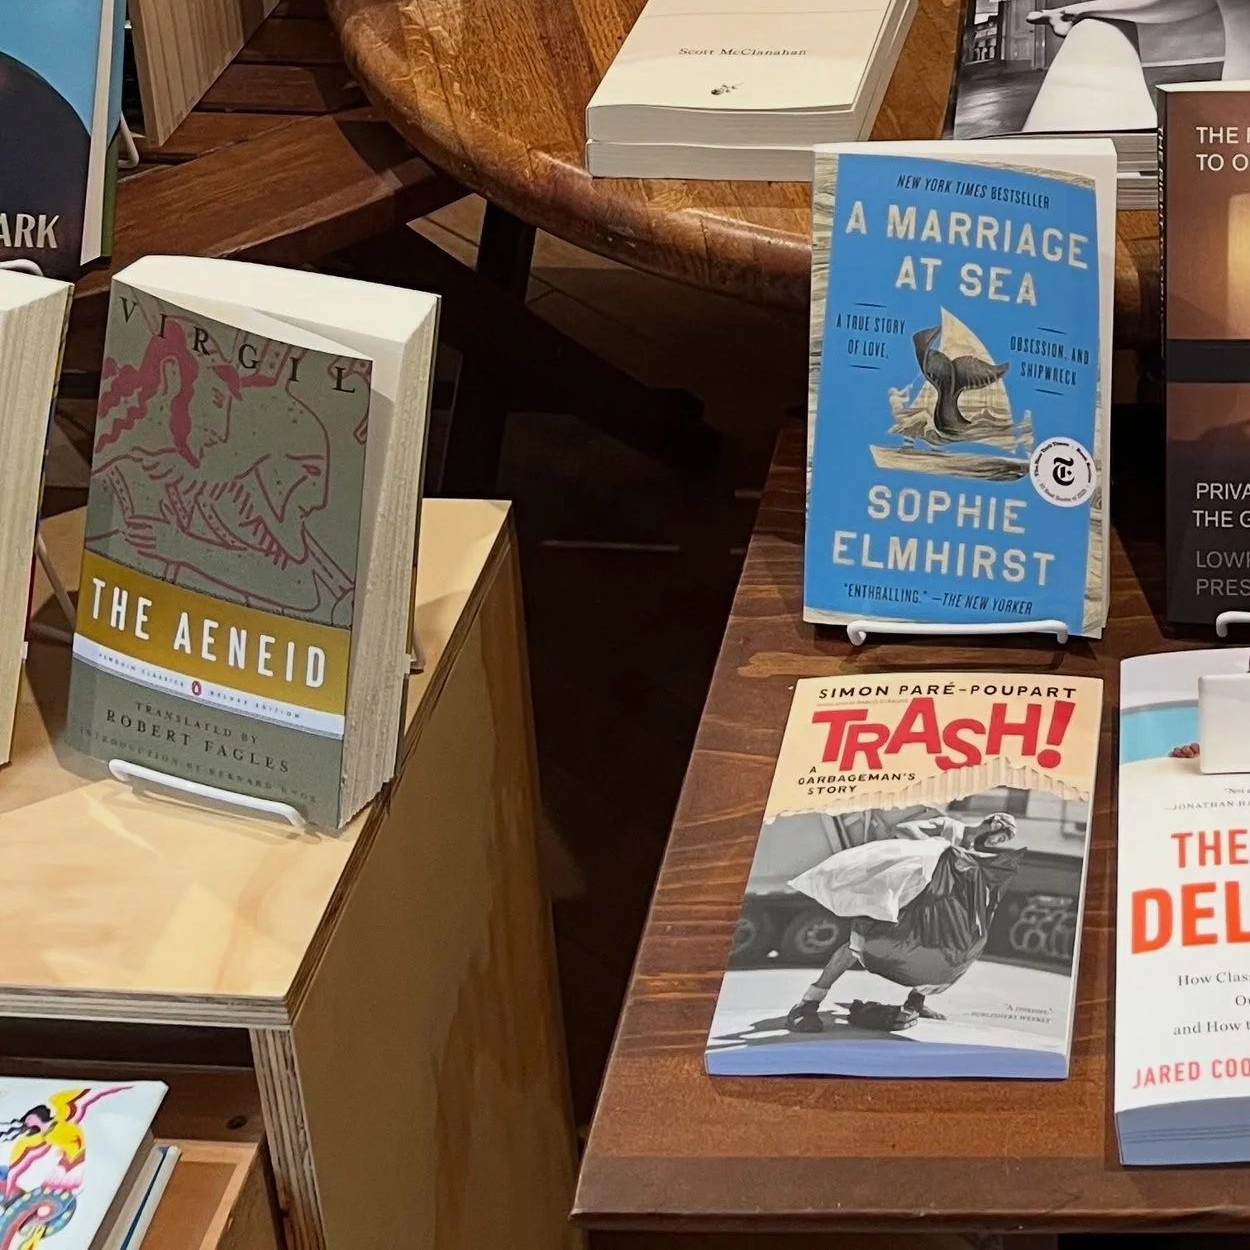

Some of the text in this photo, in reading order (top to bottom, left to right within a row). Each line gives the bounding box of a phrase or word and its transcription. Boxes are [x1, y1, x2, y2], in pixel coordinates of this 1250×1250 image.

[679, 47, 808, 56] Scott McClanahan
[1196, 126, 1238, 144] THE
[1196, 153, 1224, 172] TO
[897, 174, 1050, 210] NEW YORK TIMES BESTSELLER
[845, 200, 1089, 270] A MARRIAGE
[895, 255, 1037, 307] AT SEA
[120, 296, 355, 394] VIRGIL
[867, 484, 1027, 534] SOPHIE
[832, 530, 1055, 586] ELMHIRST
[92, 577, 326, 689] THE AENEID
[819, 682, 1077, 699] SIMON PARÉ-POUPART
[106, 709, 290, 773] ROBERT FAGLES
[812, 697, 1075, 771] TRASH!
[798, 773, 916, 785] GARBAGEMAN'S
[1171, 830, 1250, 868] THE
